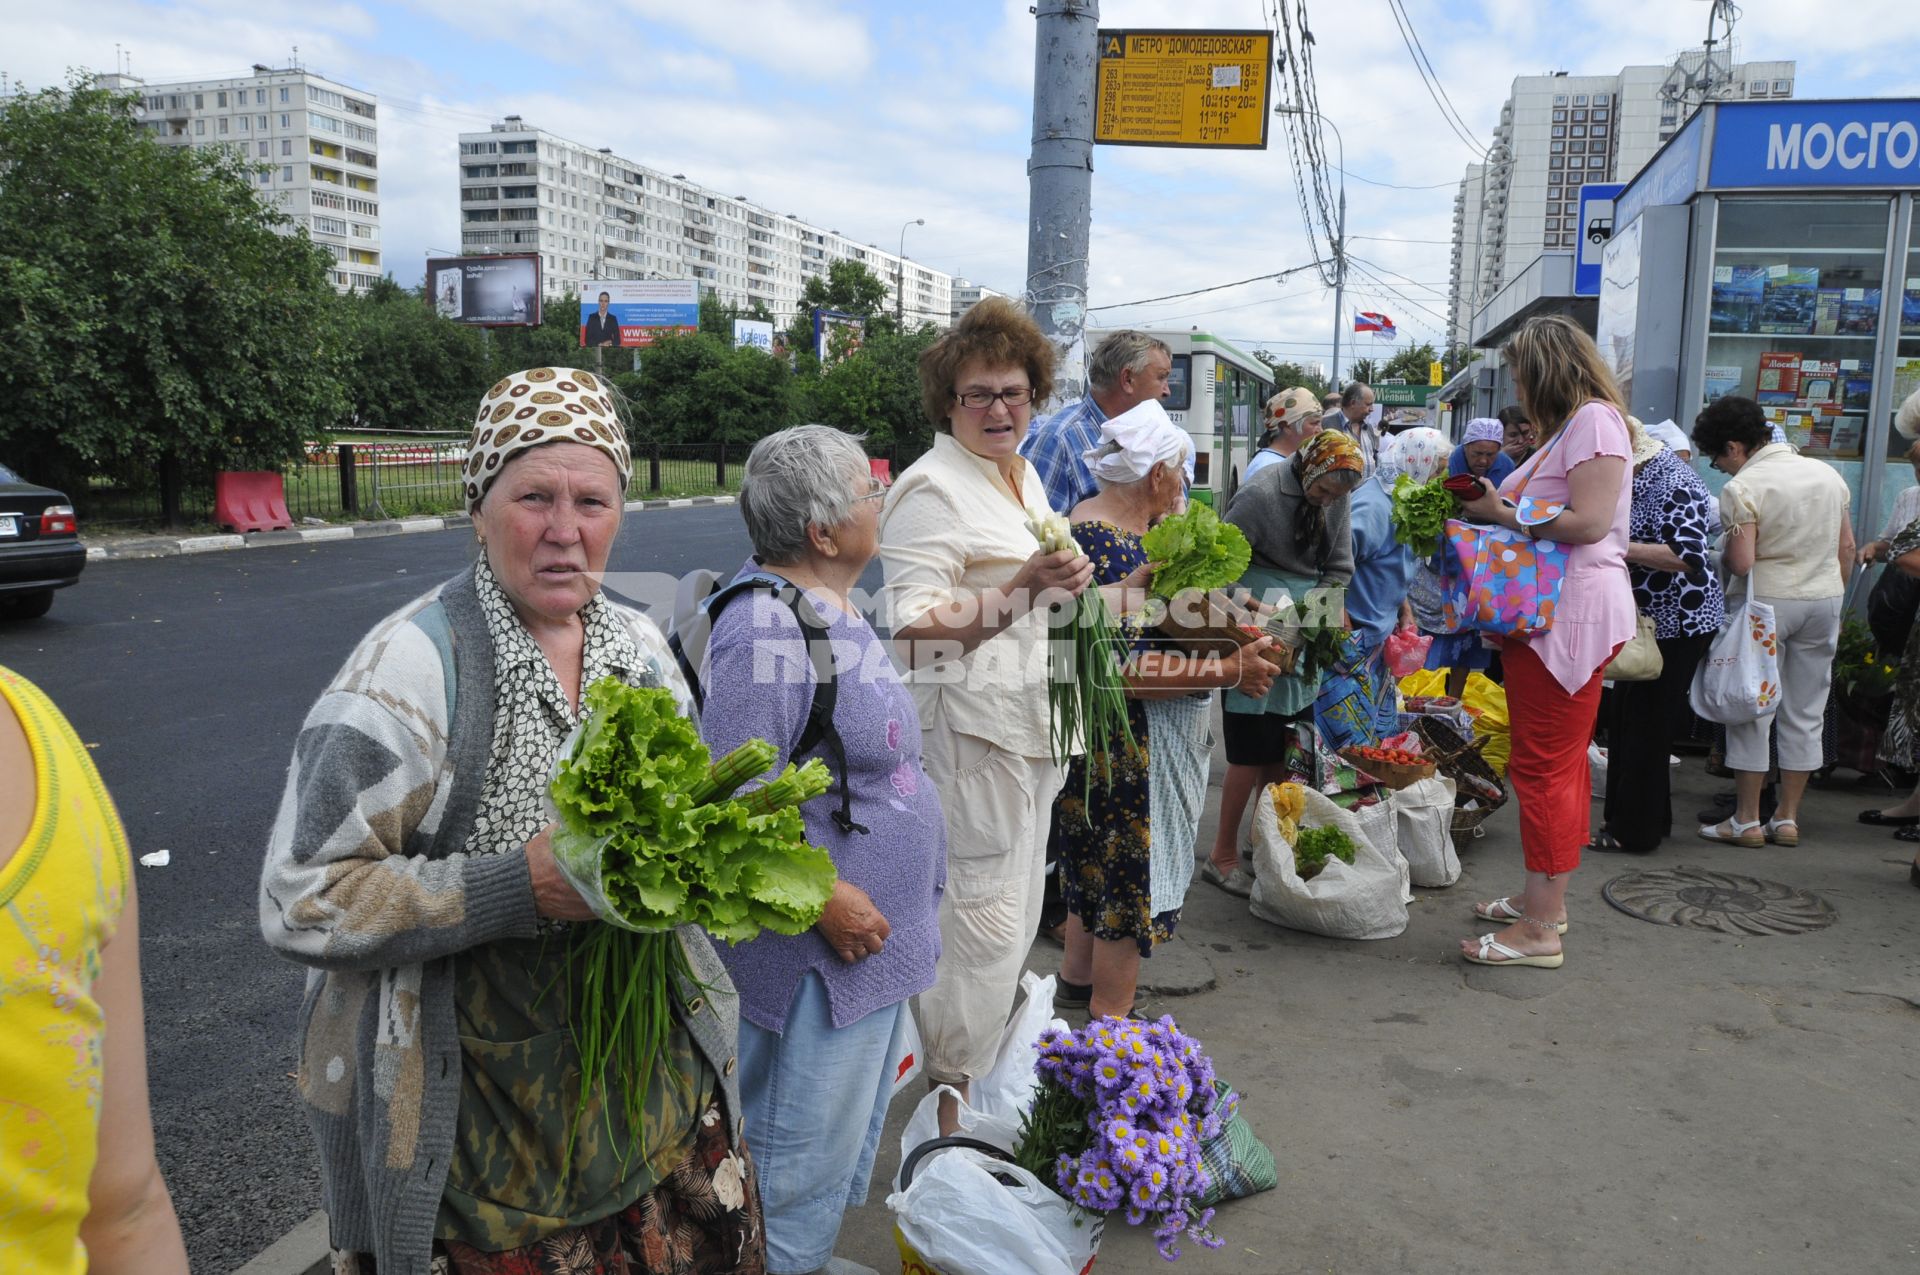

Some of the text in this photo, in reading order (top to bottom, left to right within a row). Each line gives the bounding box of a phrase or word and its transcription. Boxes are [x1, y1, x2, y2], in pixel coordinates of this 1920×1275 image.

[1131, 38, 1163, 54] МЕТРО
[1106, 69, 1119, 80] 263
[1240, 64, 1251, 77] 18
[1103, 102, 1116, 113] 274
[1201, 95, 1212, 108] 10
[1219, 95, 1230, 108] 15
[1237, 95, 1249, 109] 20
[1200, 110, 1209, 124] 11
[1219, 112, 1229, 124] 16
[1102, 124, 1115, 135] 287
[1199, 127, 1208, 140] 12
[1214, 127, 1223, 140] 17
[1767, 121, 1920, 170] МОСГО
[740, 327, 768, 345] kaleva
[1166, 413, 1183, 422] 321
